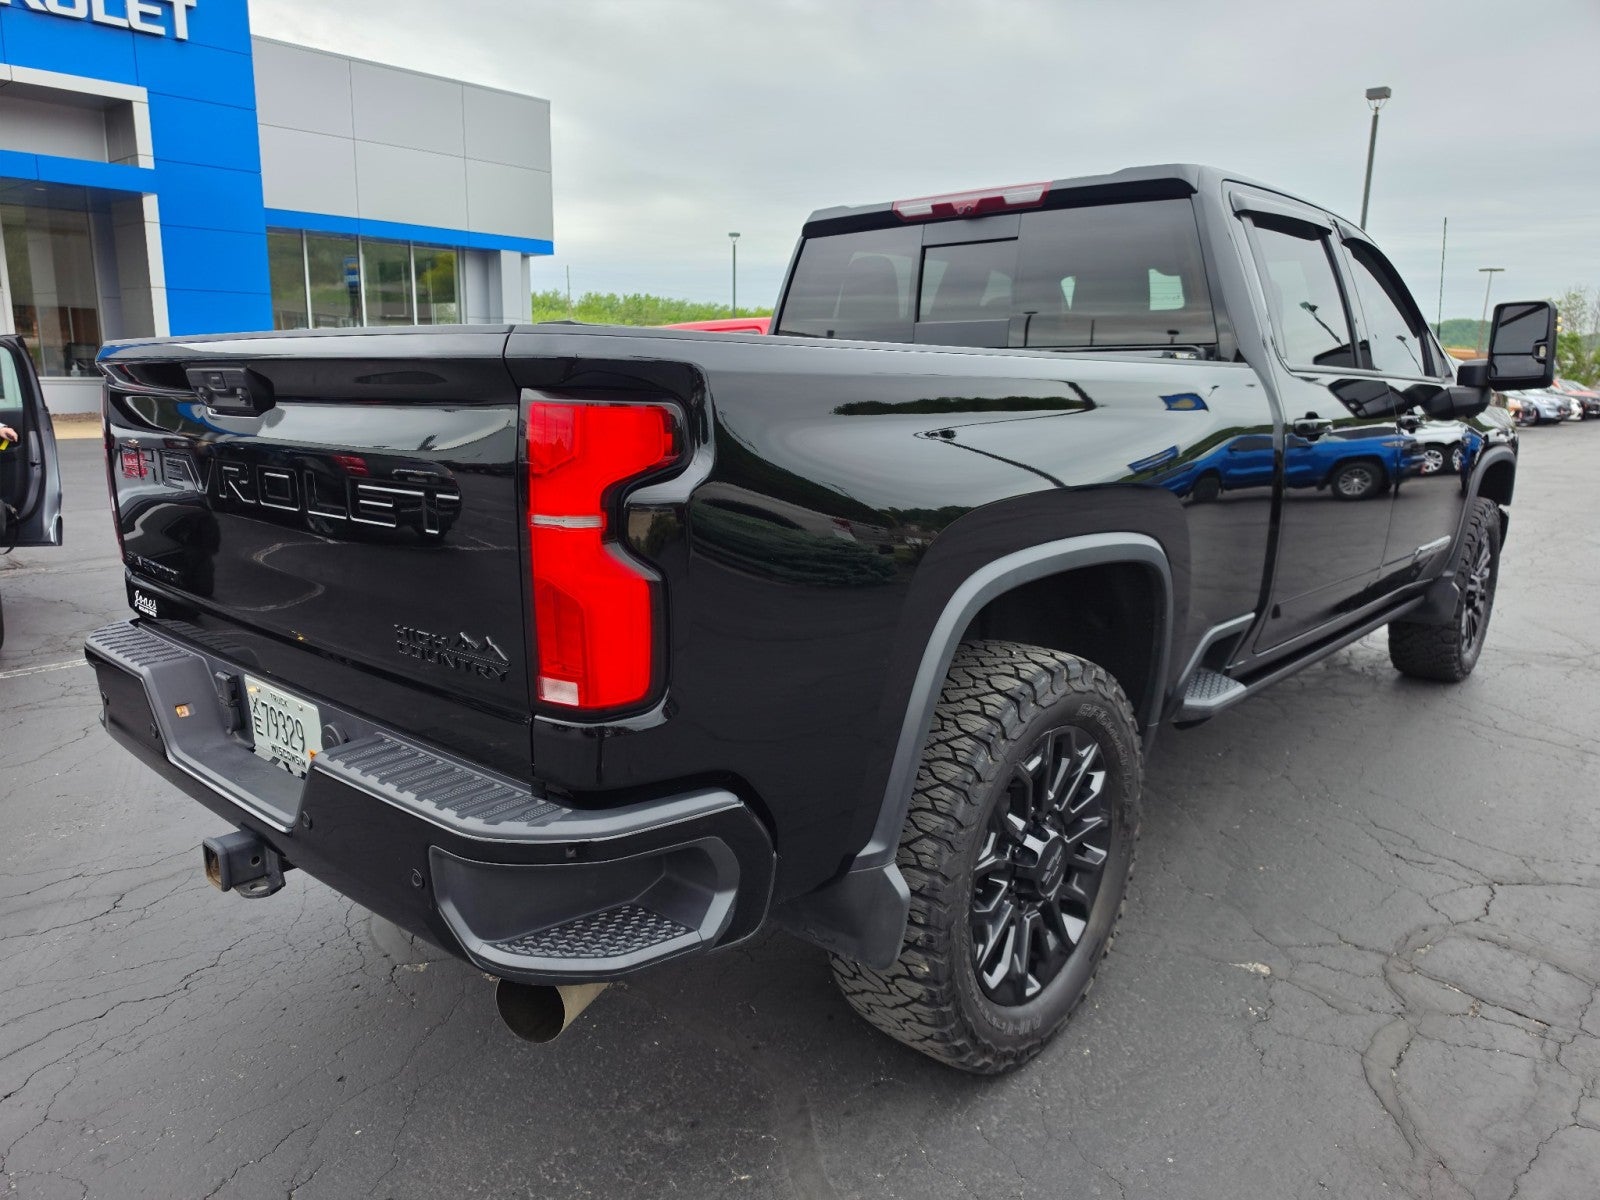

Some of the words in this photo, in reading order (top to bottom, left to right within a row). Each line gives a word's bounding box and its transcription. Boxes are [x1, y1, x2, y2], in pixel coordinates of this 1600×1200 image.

[0, 0, 197, 40] LET
[134, 590, 157, 610] Jones
[269, 692, 289, 708] TRUCK
[269, 742, 307, 769] WISCONSIN
